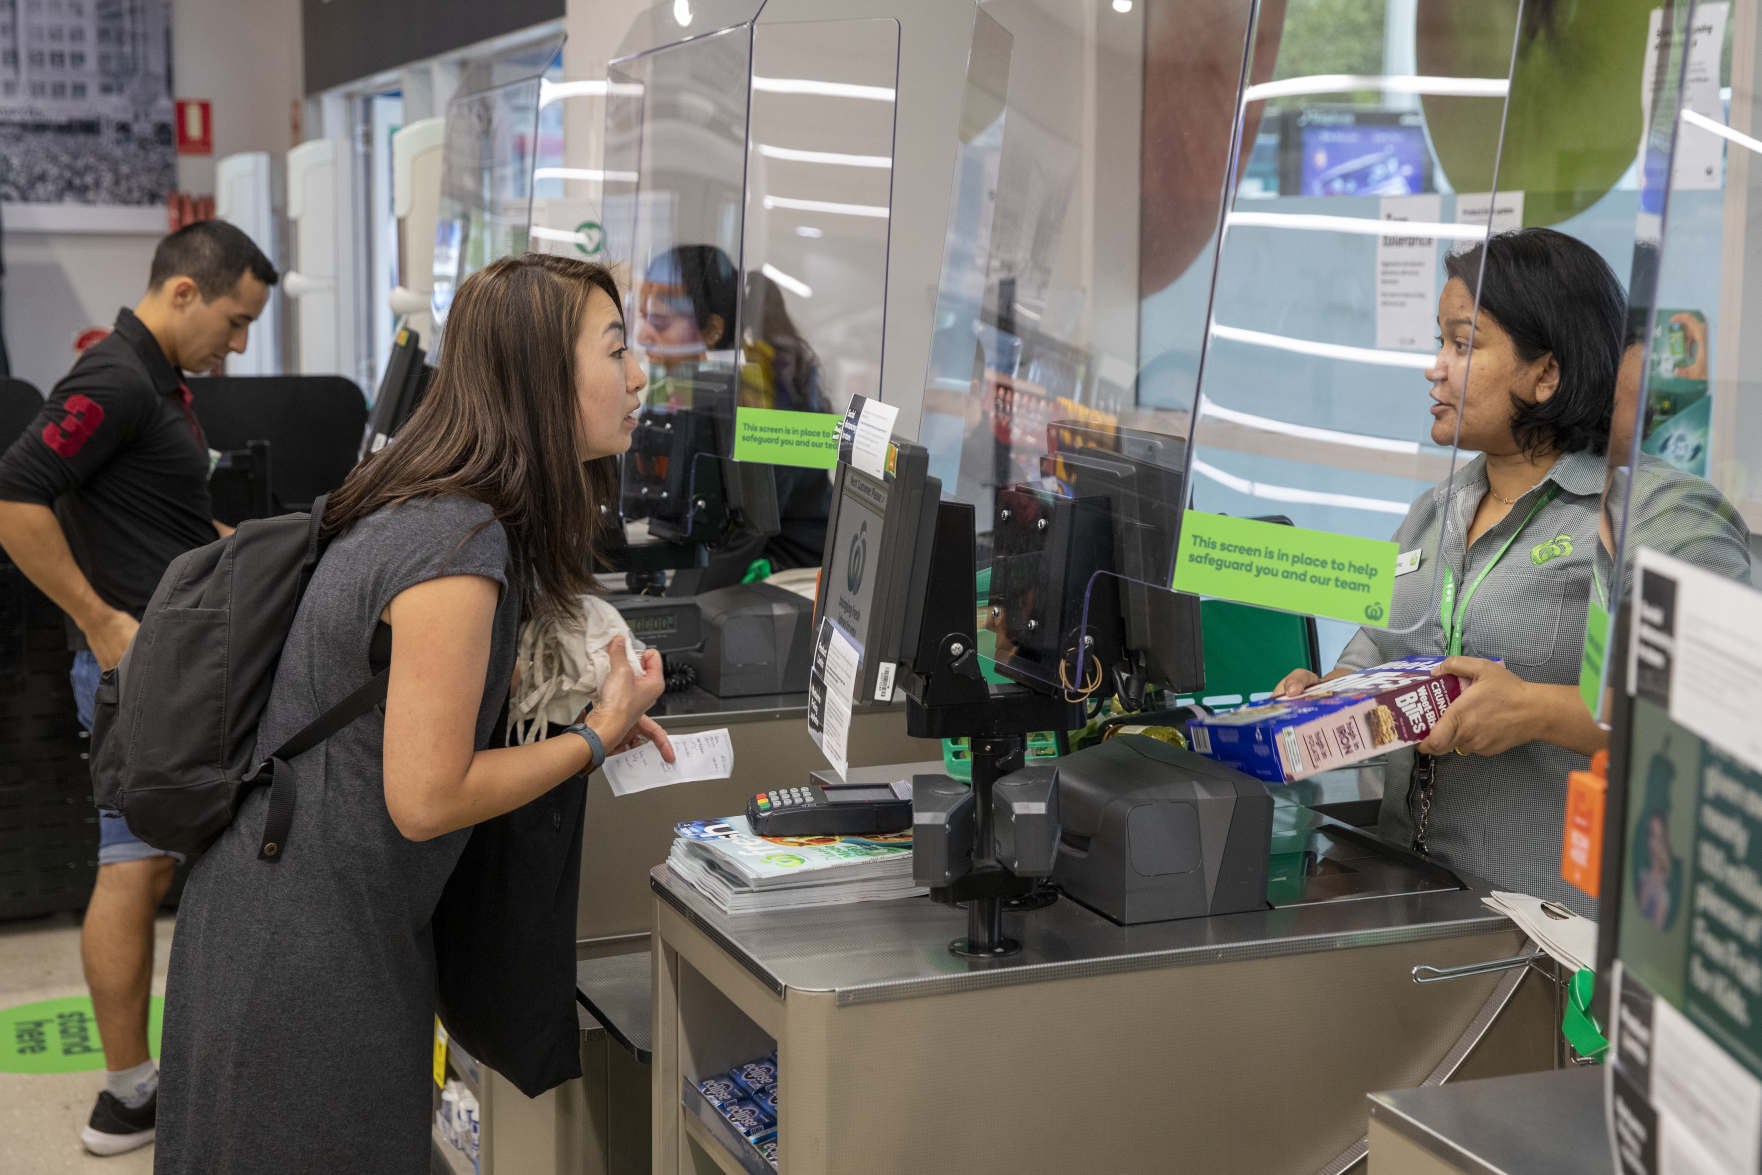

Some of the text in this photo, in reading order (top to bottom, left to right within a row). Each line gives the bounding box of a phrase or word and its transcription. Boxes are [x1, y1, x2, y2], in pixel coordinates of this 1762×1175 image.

[42, 393, 104, 458] 3
[742, 433, 838, 450] safeguard you and our tea
[743, 422, 831, 439] This screen is in place to
[1188, 553, 1371, 593] safeguard you and our team
[1191, 533, 1378, 580] This screen is in place to help
[1431, 681, 1447, 717] CRUNC
[1335, 724, 1354, 756] IRON
[14, 1018, 54, 1054] here
